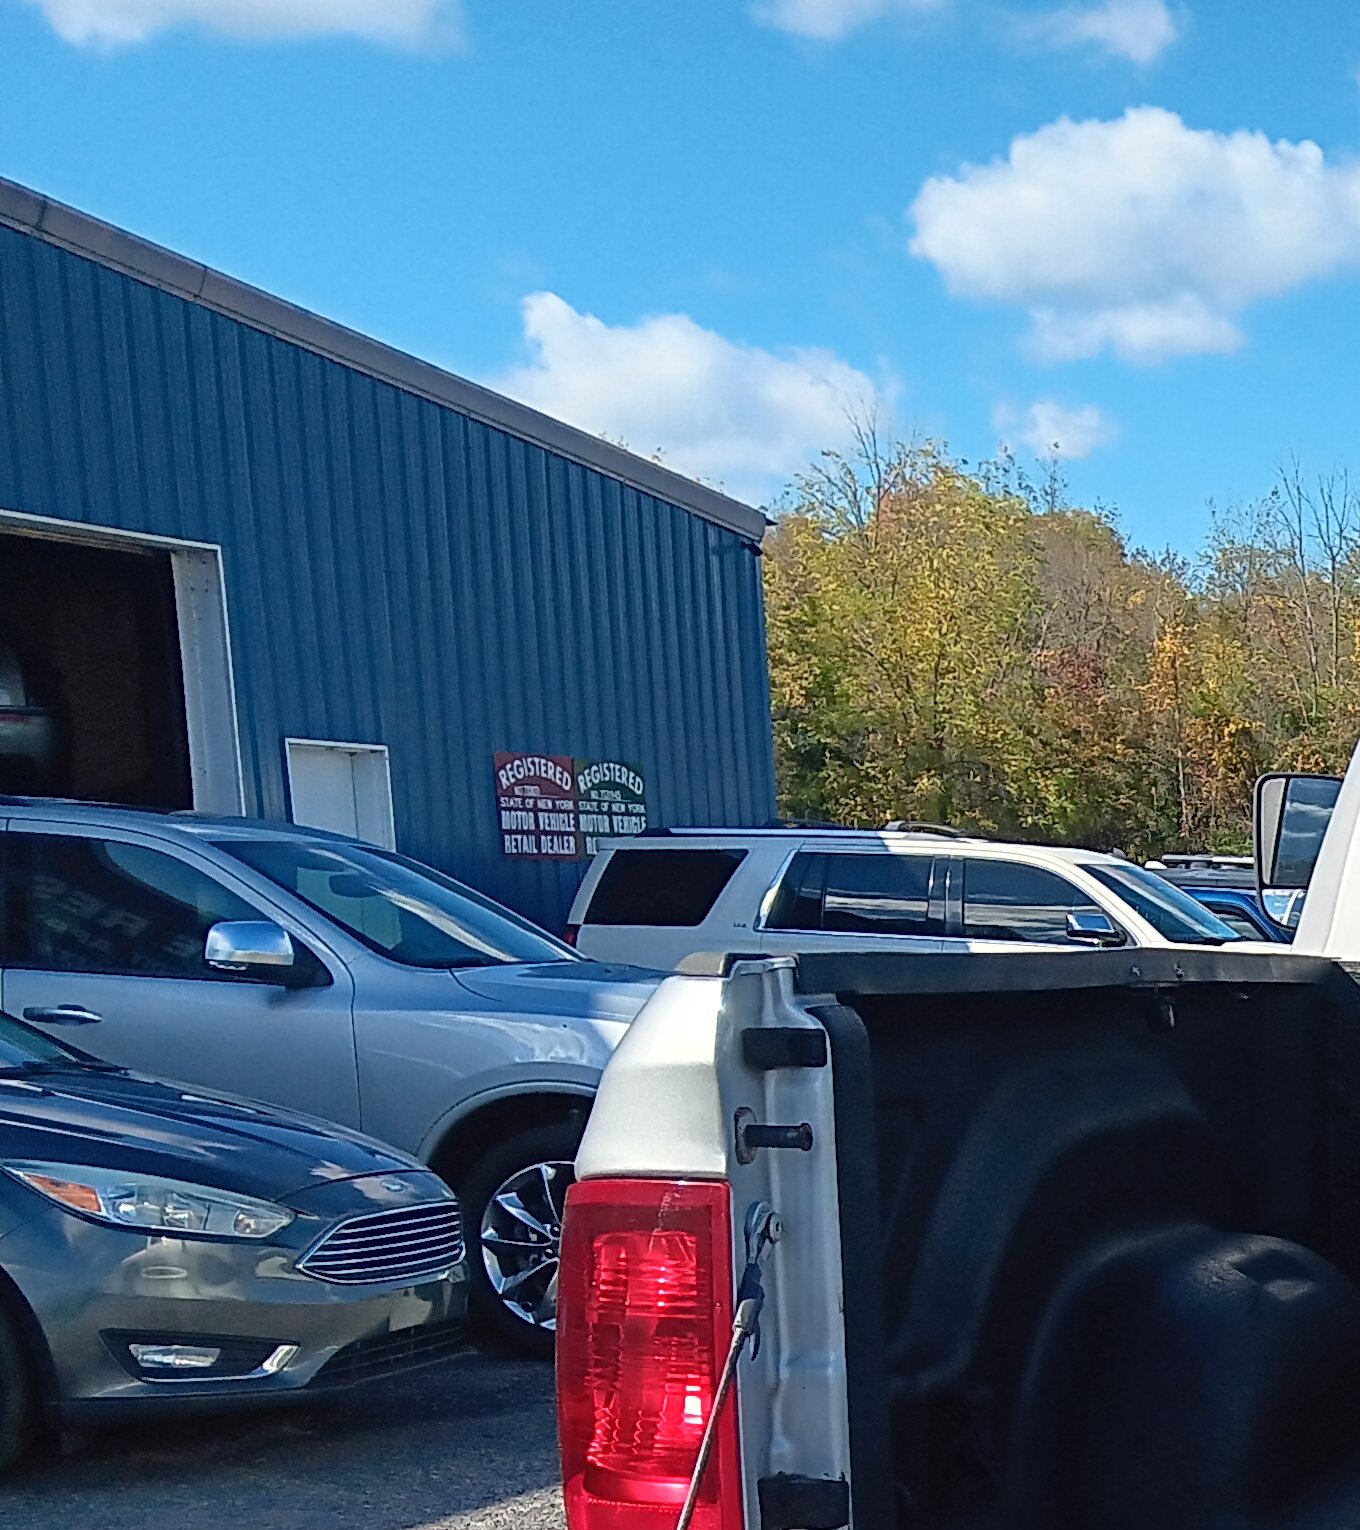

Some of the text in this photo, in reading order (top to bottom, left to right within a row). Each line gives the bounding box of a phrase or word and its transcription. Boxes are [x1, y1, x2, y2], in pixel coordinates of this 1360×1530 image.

[498, 757, 572, 790] REGISTERED
[577, 762, 644, 795] REGISTERED
[500, 797, 574, 810] STATE OF NEW YORK
[578, 800, 646, 814] STATE OF NEW YORK
[501, 811, 576, 831] MOTOR VEHICLE
[579, 814, 647, 834] MOTOR VEHICLE
[504, 834, 538, 854] RETAIL
[541, 835, 576, 854] DEALER
